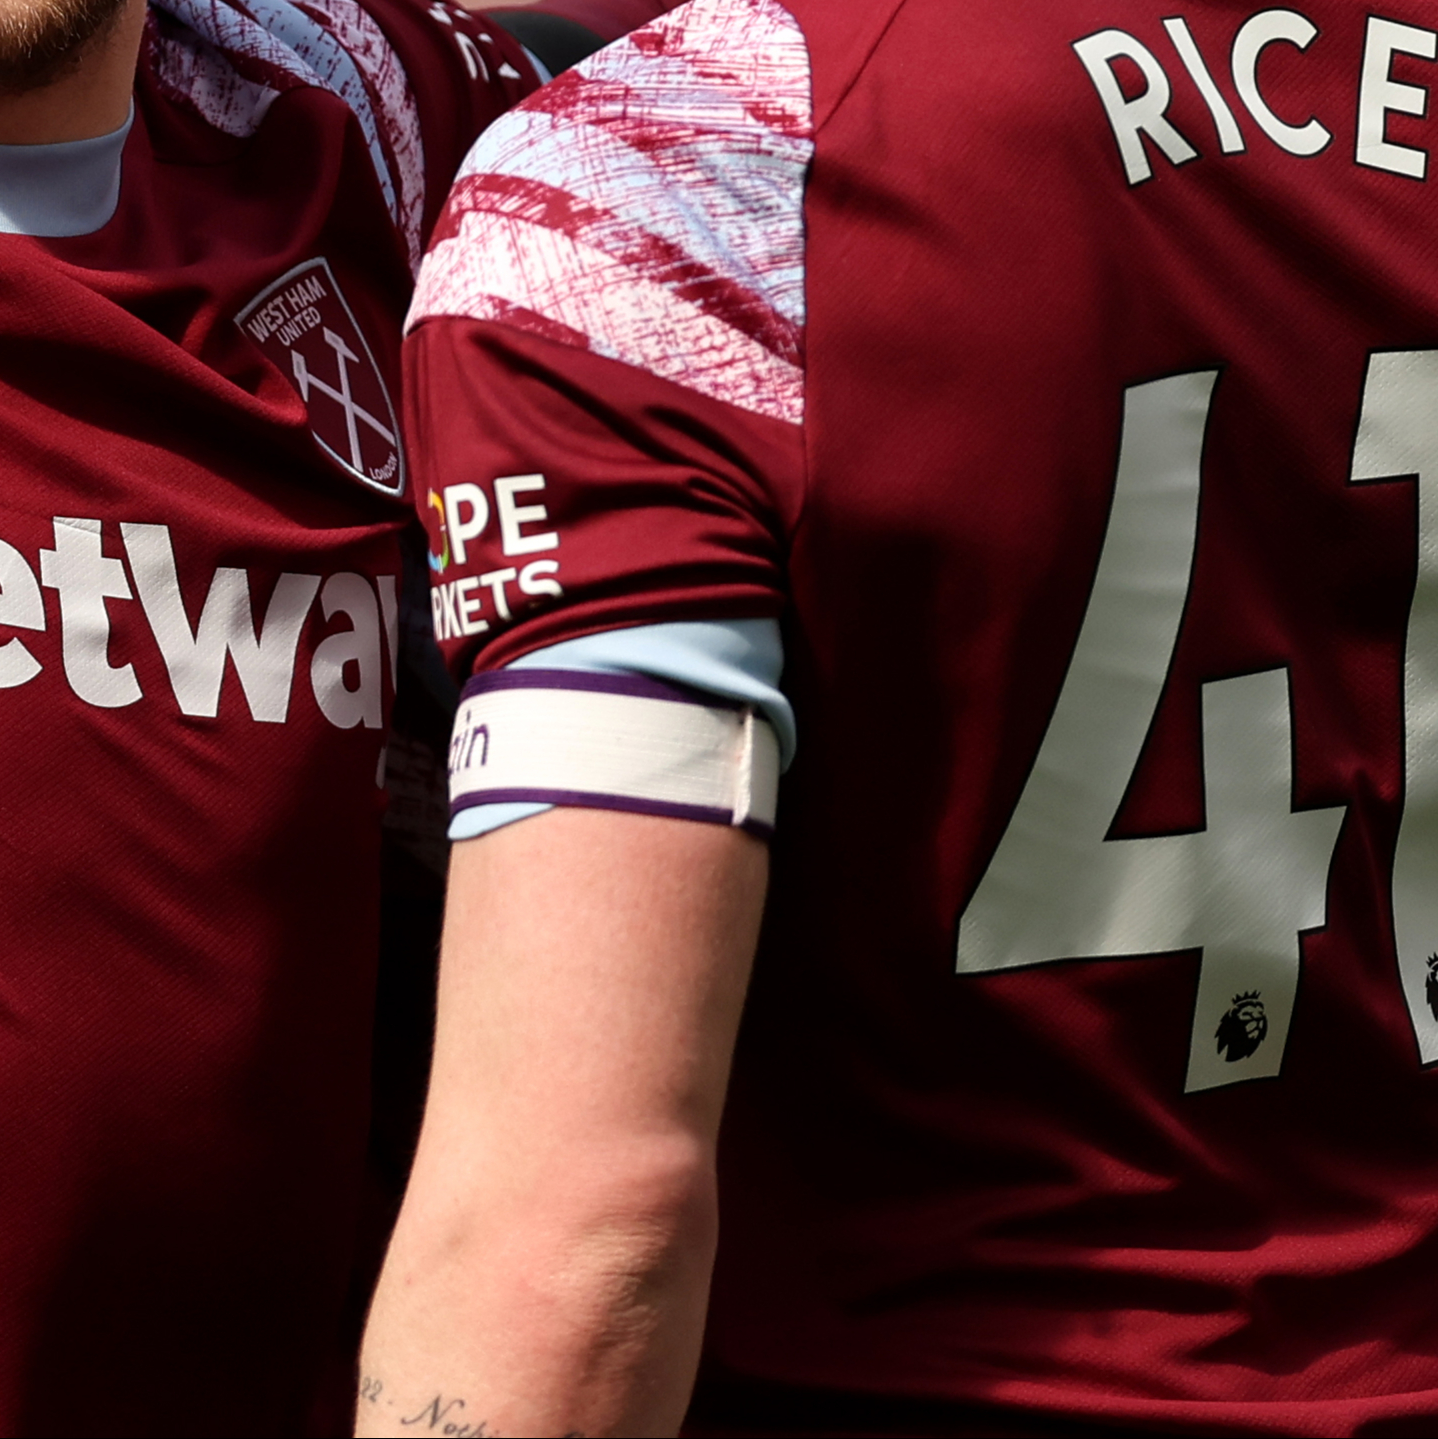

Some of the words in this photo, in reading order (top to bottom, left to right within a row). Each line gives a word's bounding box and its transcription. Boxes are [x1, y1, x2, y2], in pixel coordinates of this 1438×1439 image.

[247, 294, 286, 344] WEST
[285, 275, 327, 312] HAM
[276, 306, 322, 347] UNITED
[369, 452, 398, 481] LONDON
[430, 558, 564, 642] RKETS
